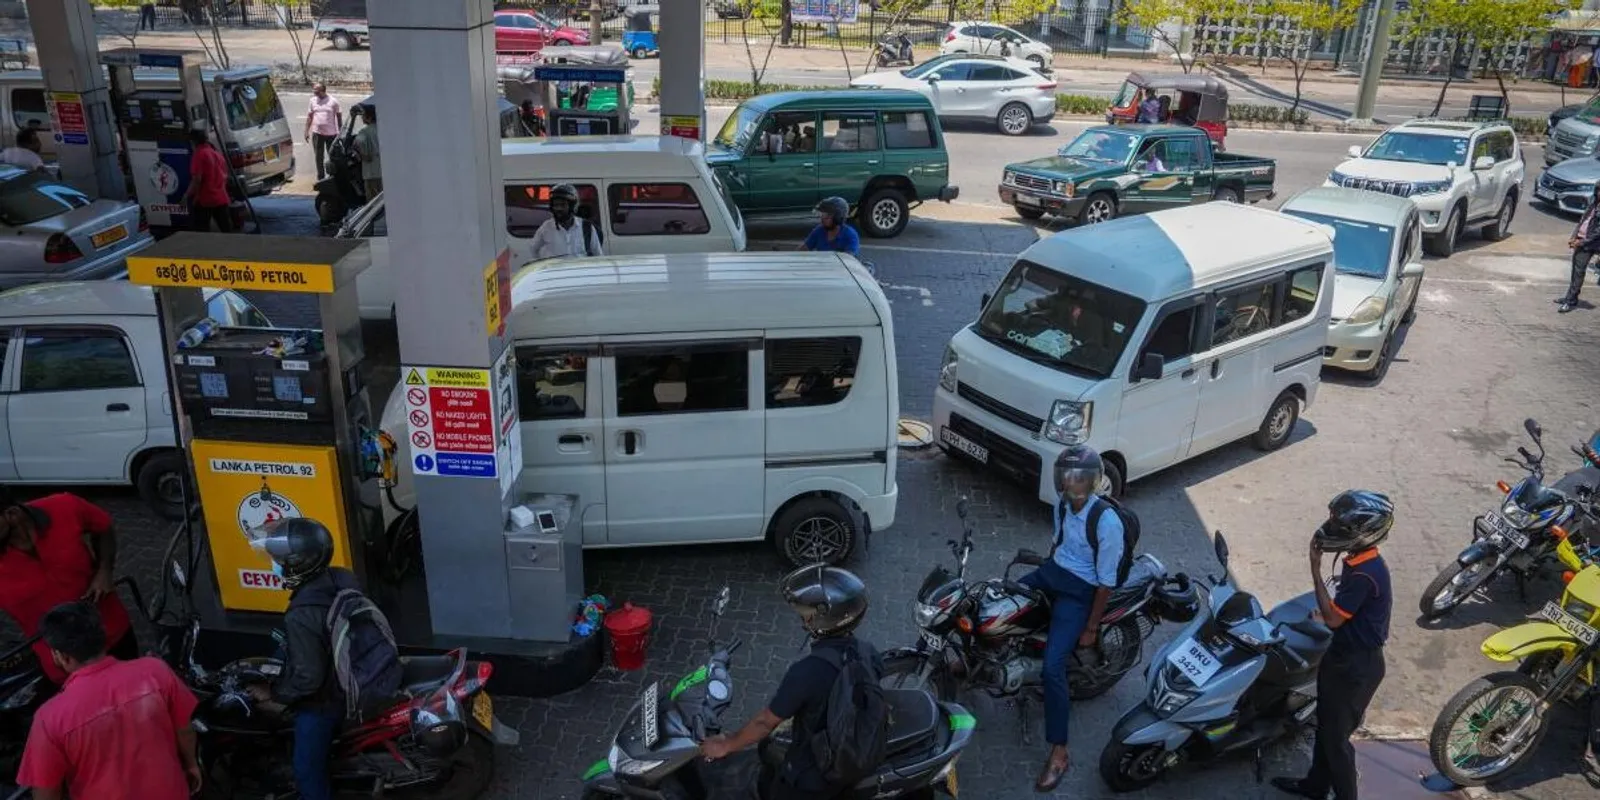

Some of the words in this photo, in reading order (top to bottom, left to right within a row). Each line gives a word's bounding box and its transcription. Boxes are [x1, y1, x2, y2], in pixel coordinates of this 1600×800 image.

[261, 270, 307, 284] PETROL
[436, 370, 481, 379] WARNING
[441, 390, 450, 398] NO
[466, 412, 487, 420] LIGHTS
[468, 434, 491, 442] PHONES
[213, 461, 253, 472] LANKA
[254, 463, 298, 475] PETROL
[300, 466, 312, 476] 92
[1190, 646, 1211, 666] BKU
[1178, 656, 1202, 677] 3427
